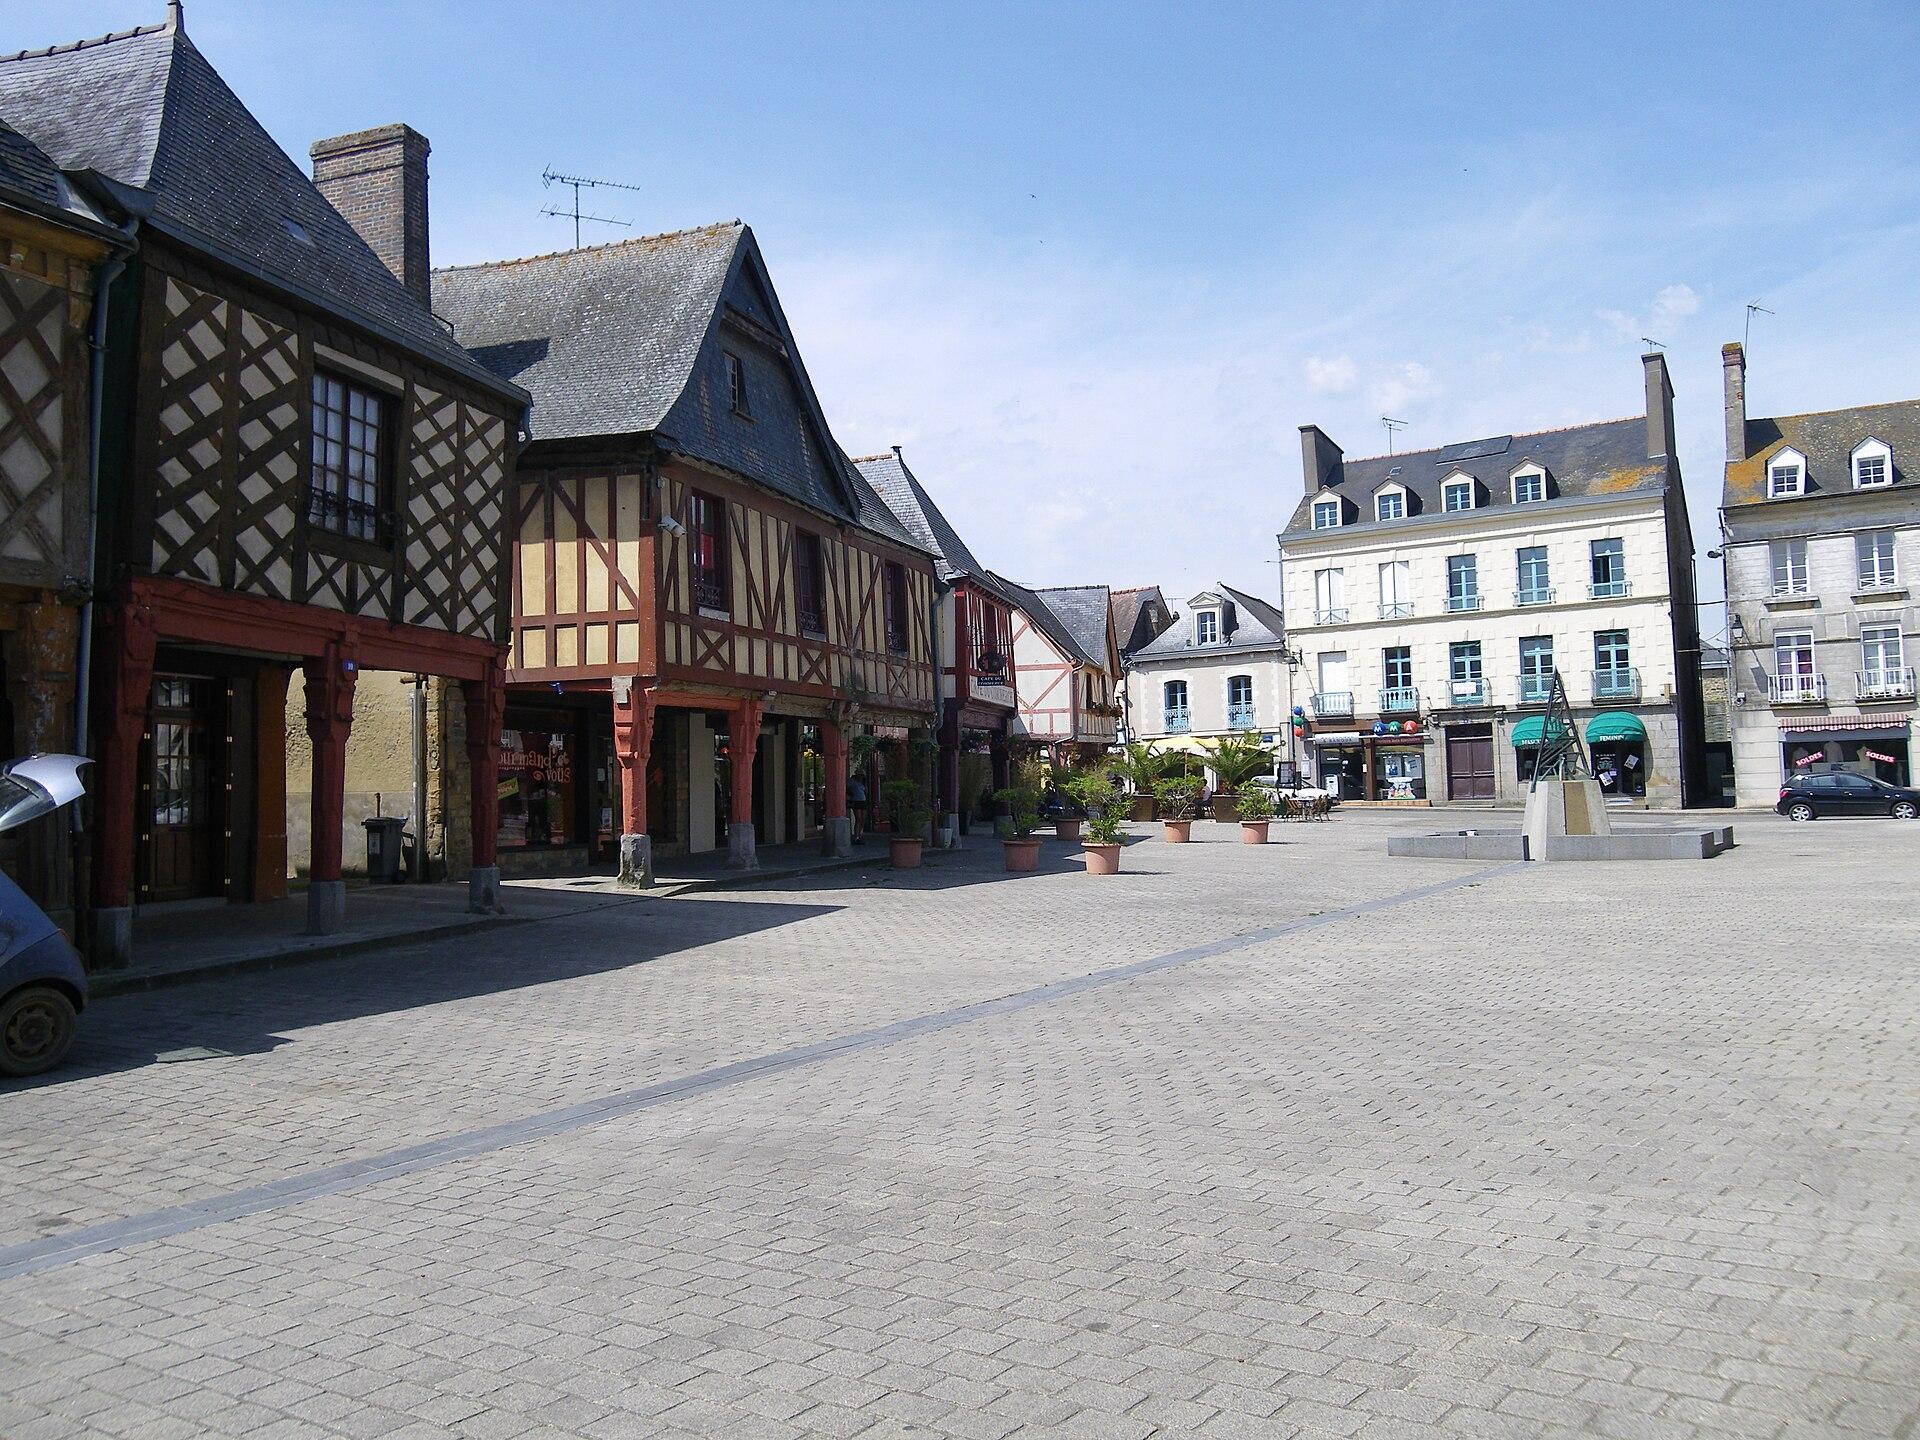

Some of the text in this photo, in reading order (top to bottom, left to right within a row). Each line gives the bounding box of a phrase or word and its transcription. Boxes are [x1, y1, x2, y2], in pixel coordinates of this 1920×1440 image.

[1796, 751, 1823, 767] SOLDES
[1865, 751, 1895, 763] SOLDES
[545, 768, 571, 784] vous
